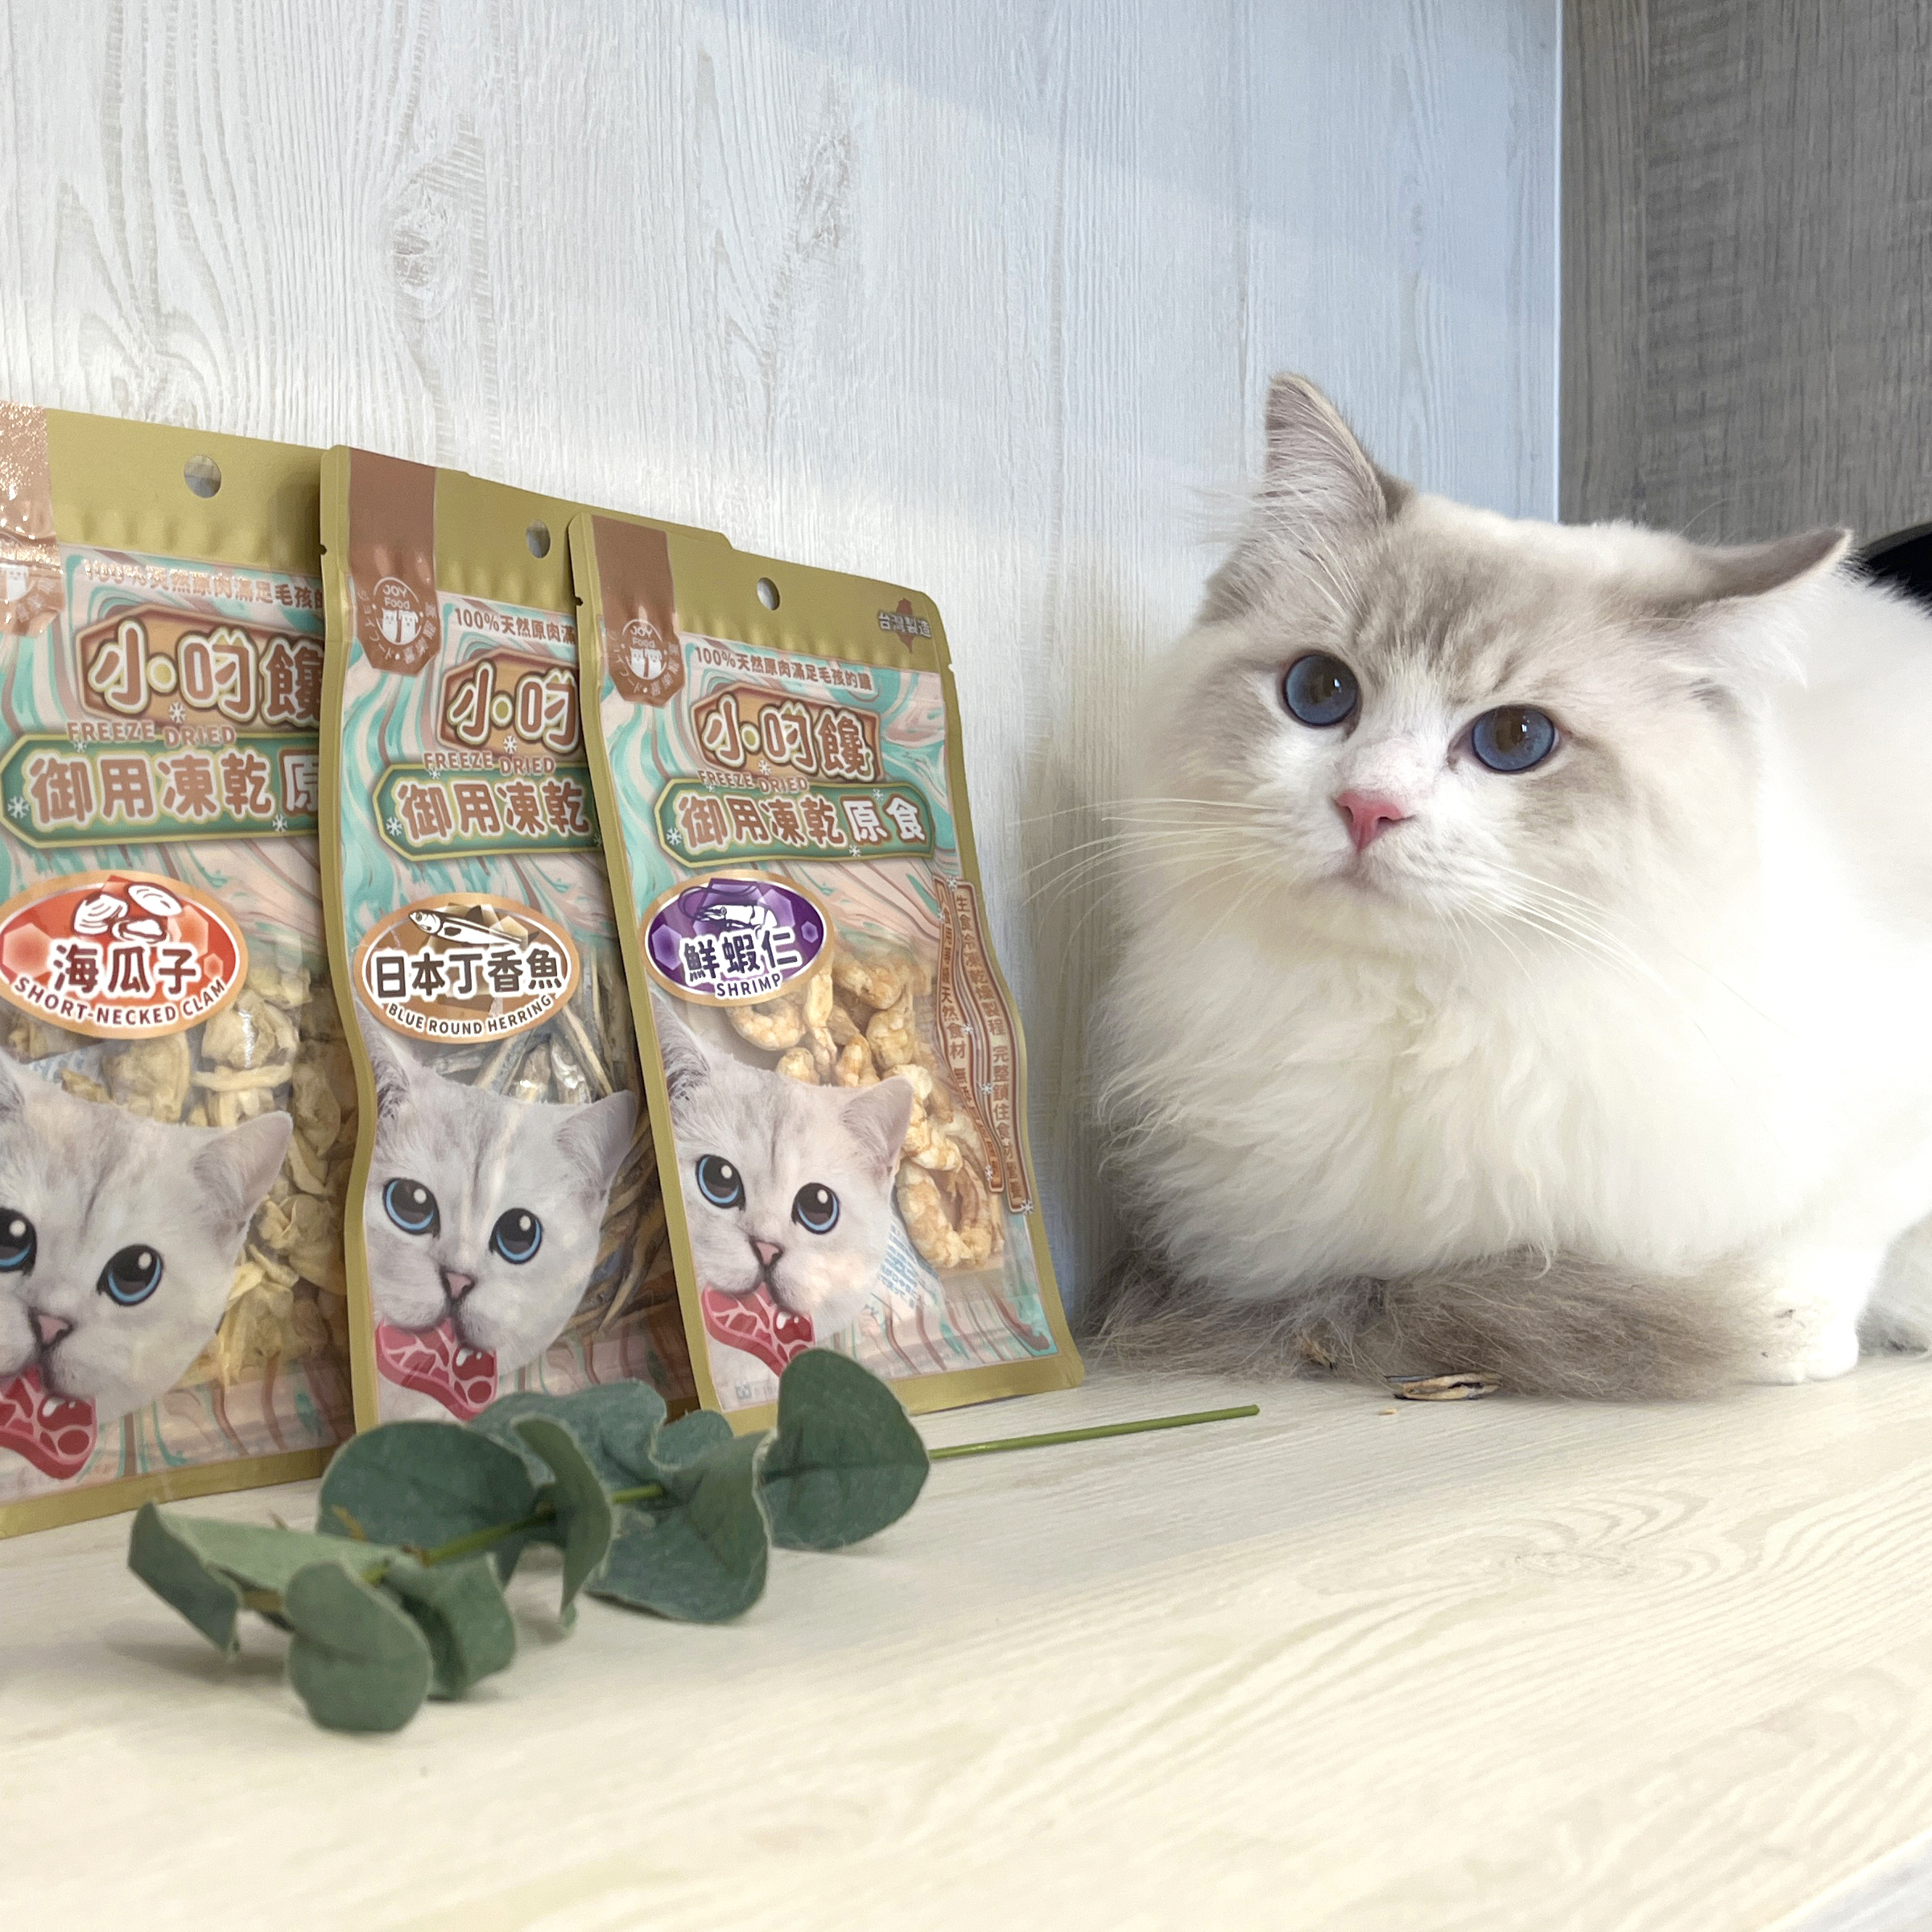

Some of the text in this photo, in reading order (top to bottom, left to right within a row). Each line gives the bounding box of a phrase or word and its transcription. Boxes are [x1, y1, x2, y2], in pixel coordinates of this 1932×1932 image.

[383, 584, 407, 597] JOY
[630, 625, 652, 638] JOY
[878, 612, 931, 638] 台灣製造
[67, 722, 235, 746] FREEZE DRIED
[423, 751, 555, 775] FREEZE DRIED
[29, 752, 318, 824] 御用凍乾原
[698, 770, 808, 794] FREEZE DRIED
[397, 779, 589, 839] 御用凍乾
[53, 943, 196, 993] 海瓜子
[683, 930, 798, 981] 鮮蝦仁
[376, 948, 562, 998] 日本丁香魚
[716, 972, 781, 997] SHRIMP
[14, 977, 226, 1025] SHORT-NECKED CLAM
[387, 994, 551, 1035] BLUE ROUND HERRING
